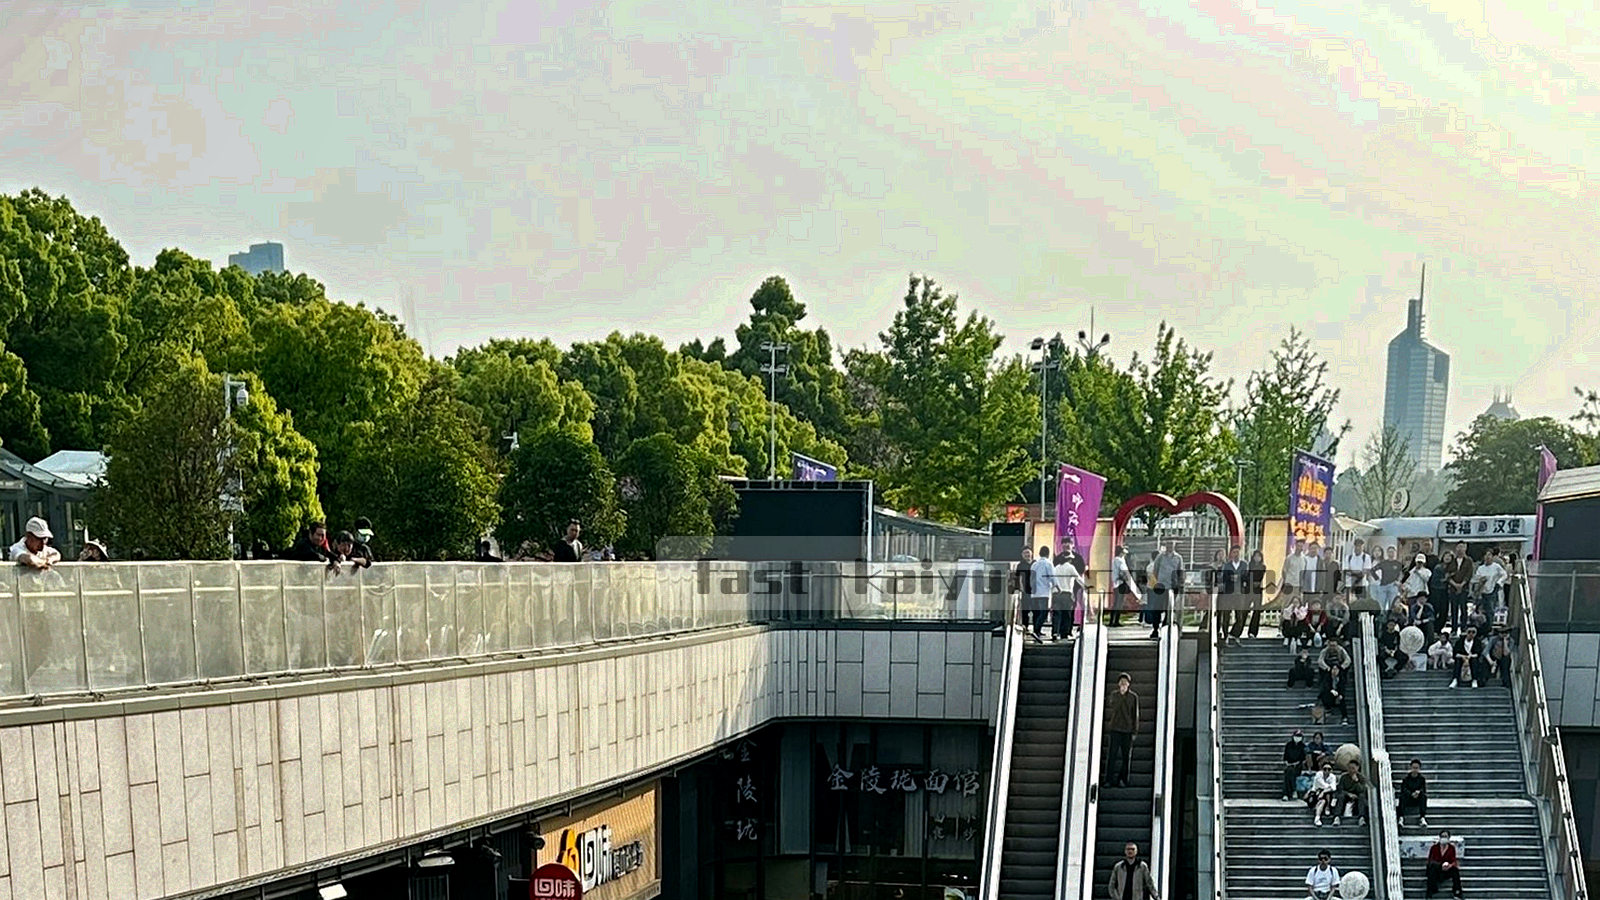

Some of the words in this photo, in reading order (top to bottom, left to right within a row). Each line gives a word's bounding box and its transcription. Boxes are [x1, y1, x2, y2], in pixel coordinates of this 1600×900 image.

[1445, 520, 1472, 535] 奇福
[1493, 519, 1521, 535] 汉堡
[534, 878, 576, 898] 回味
